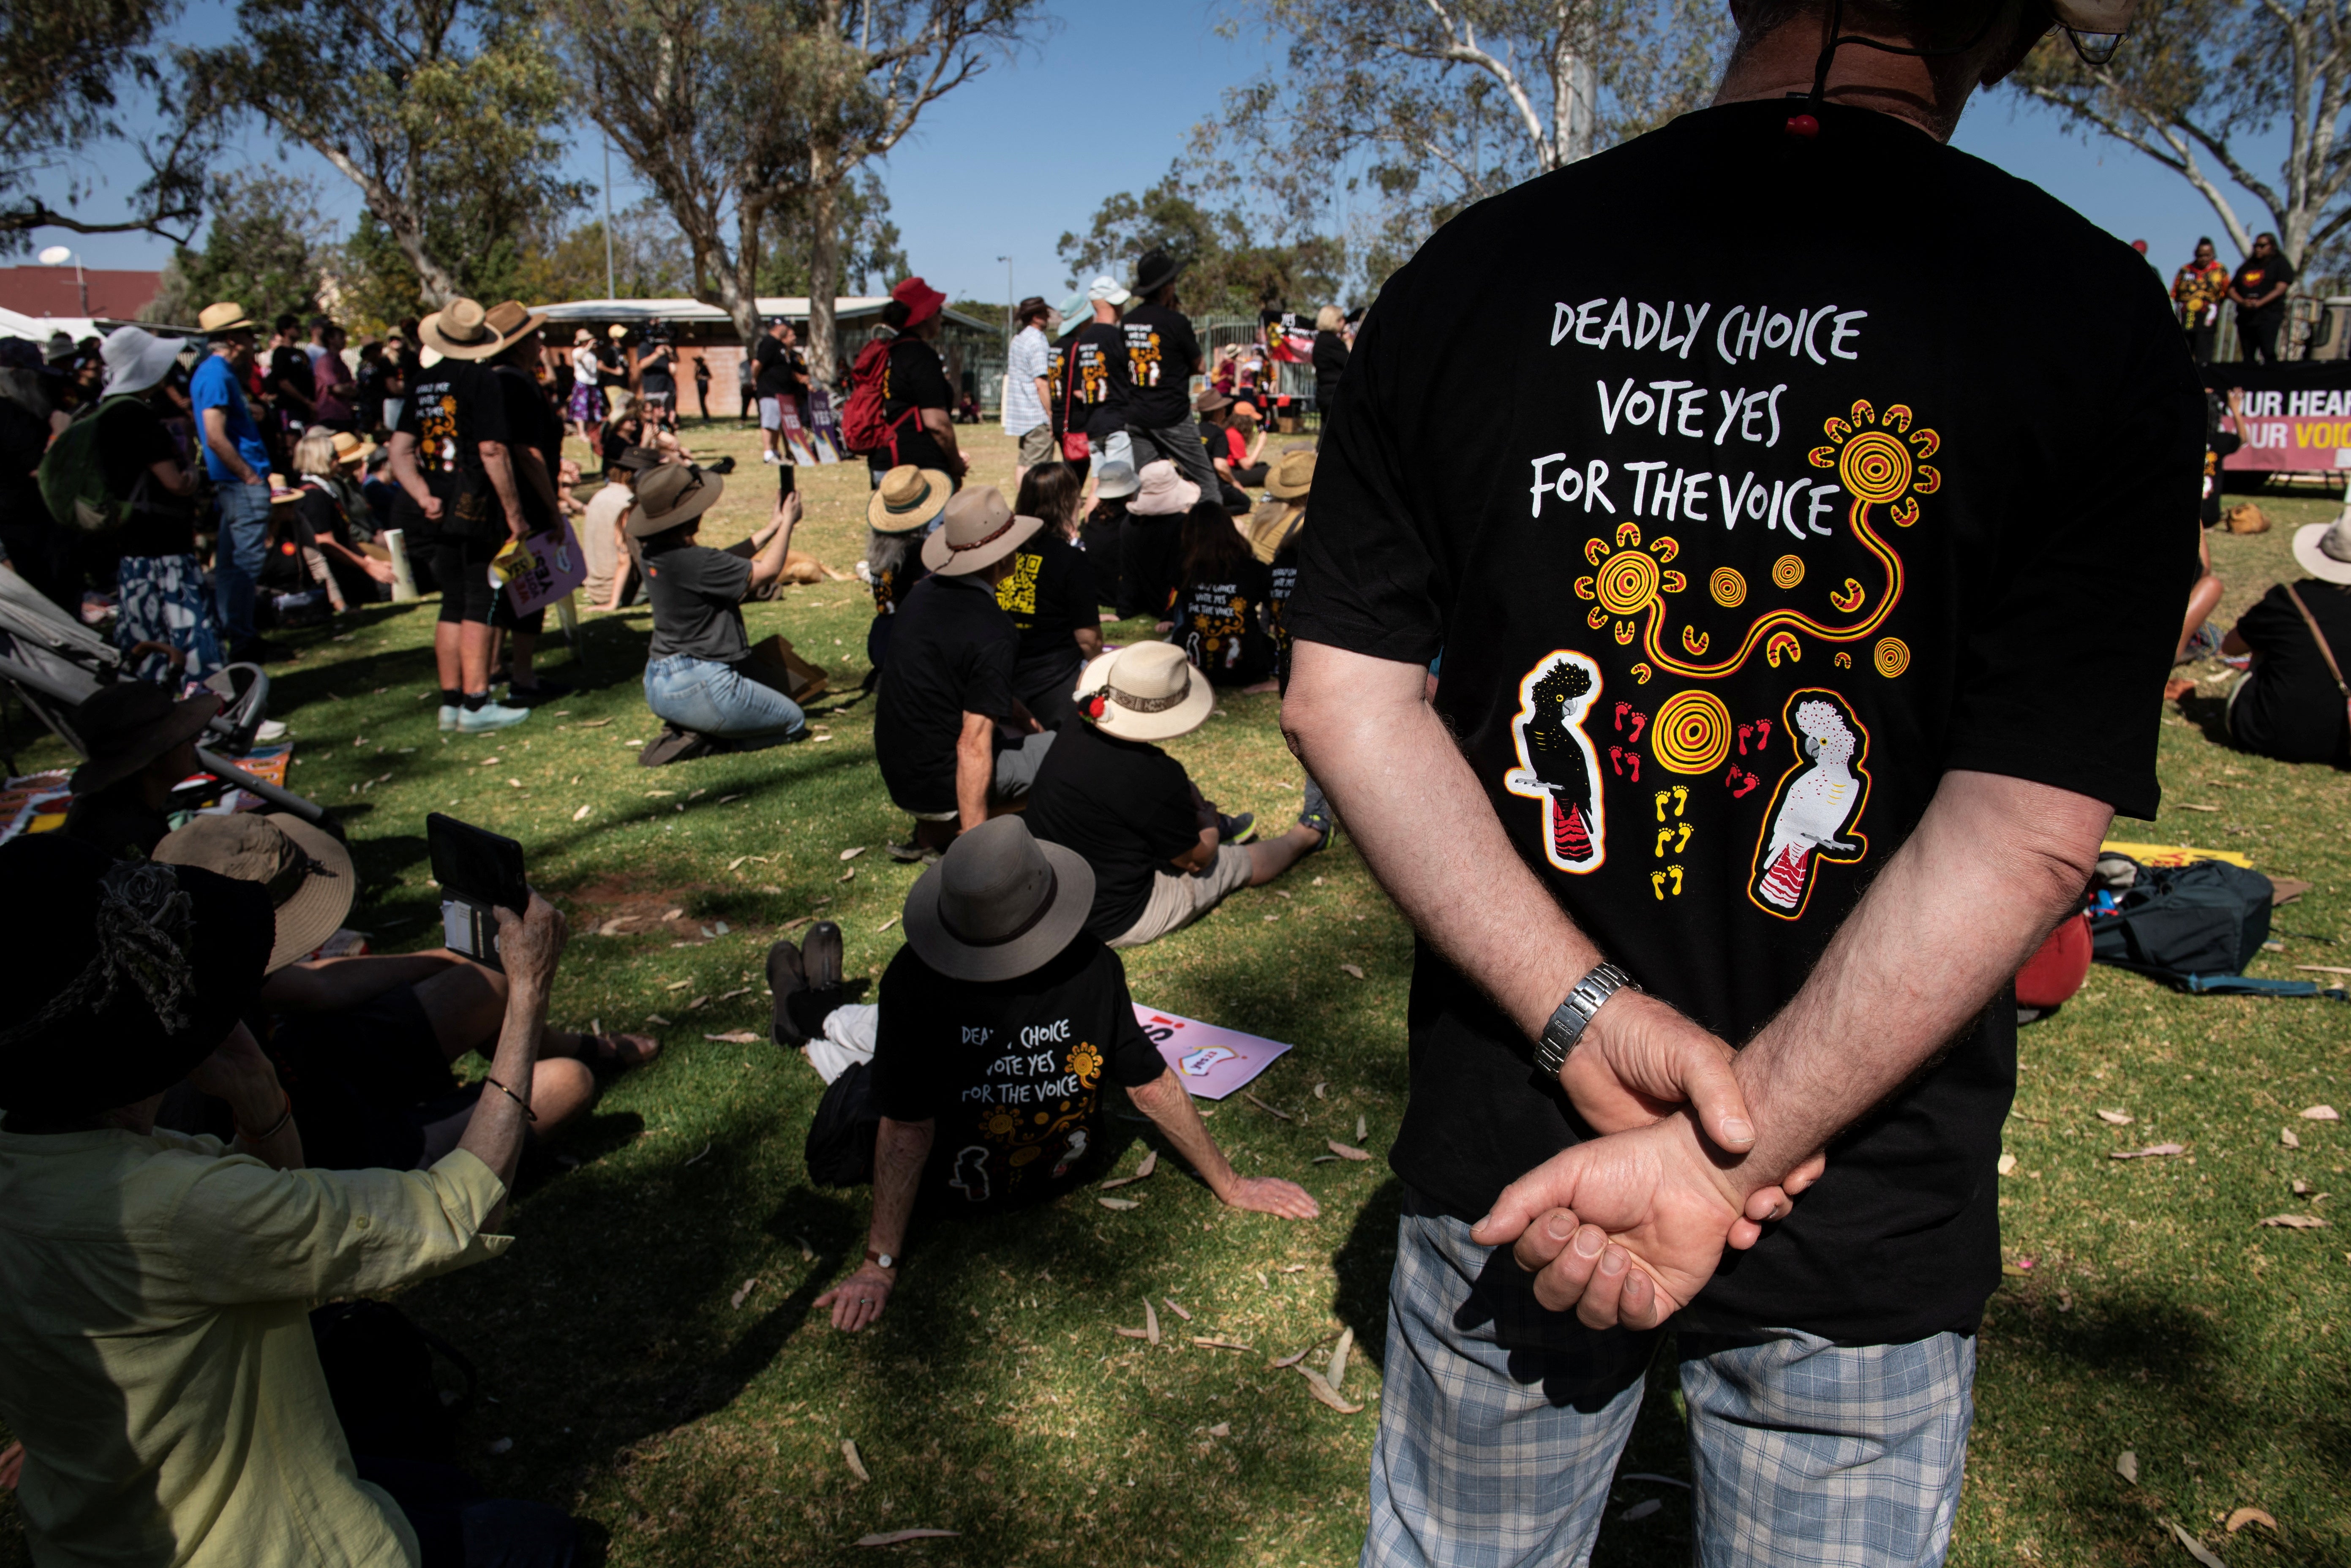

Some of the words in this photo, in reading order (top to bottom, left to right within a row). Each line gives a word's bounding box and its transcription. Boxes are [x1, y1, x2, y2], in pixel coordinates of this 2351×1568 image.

[1551, 297, 1710, 359] DEADLY
[1717, 305, 1868, 365] CHOICE
[1597, 378, 1708, 438] VOTE
[1714, 384, 1787, 447] YES
[1530, 453, 1615, 518] FOR
[1624, 461, 1712, 521] THE
[1719, 471, 1840, 540] VOICE
[1020, 1018, 1071, 1049] CHOICE
[1027, 1050, 1055, 1077] YES
[997, 1083, 1031, 1104] THE
[1034, 1074, 1079, 1102] VOICE
